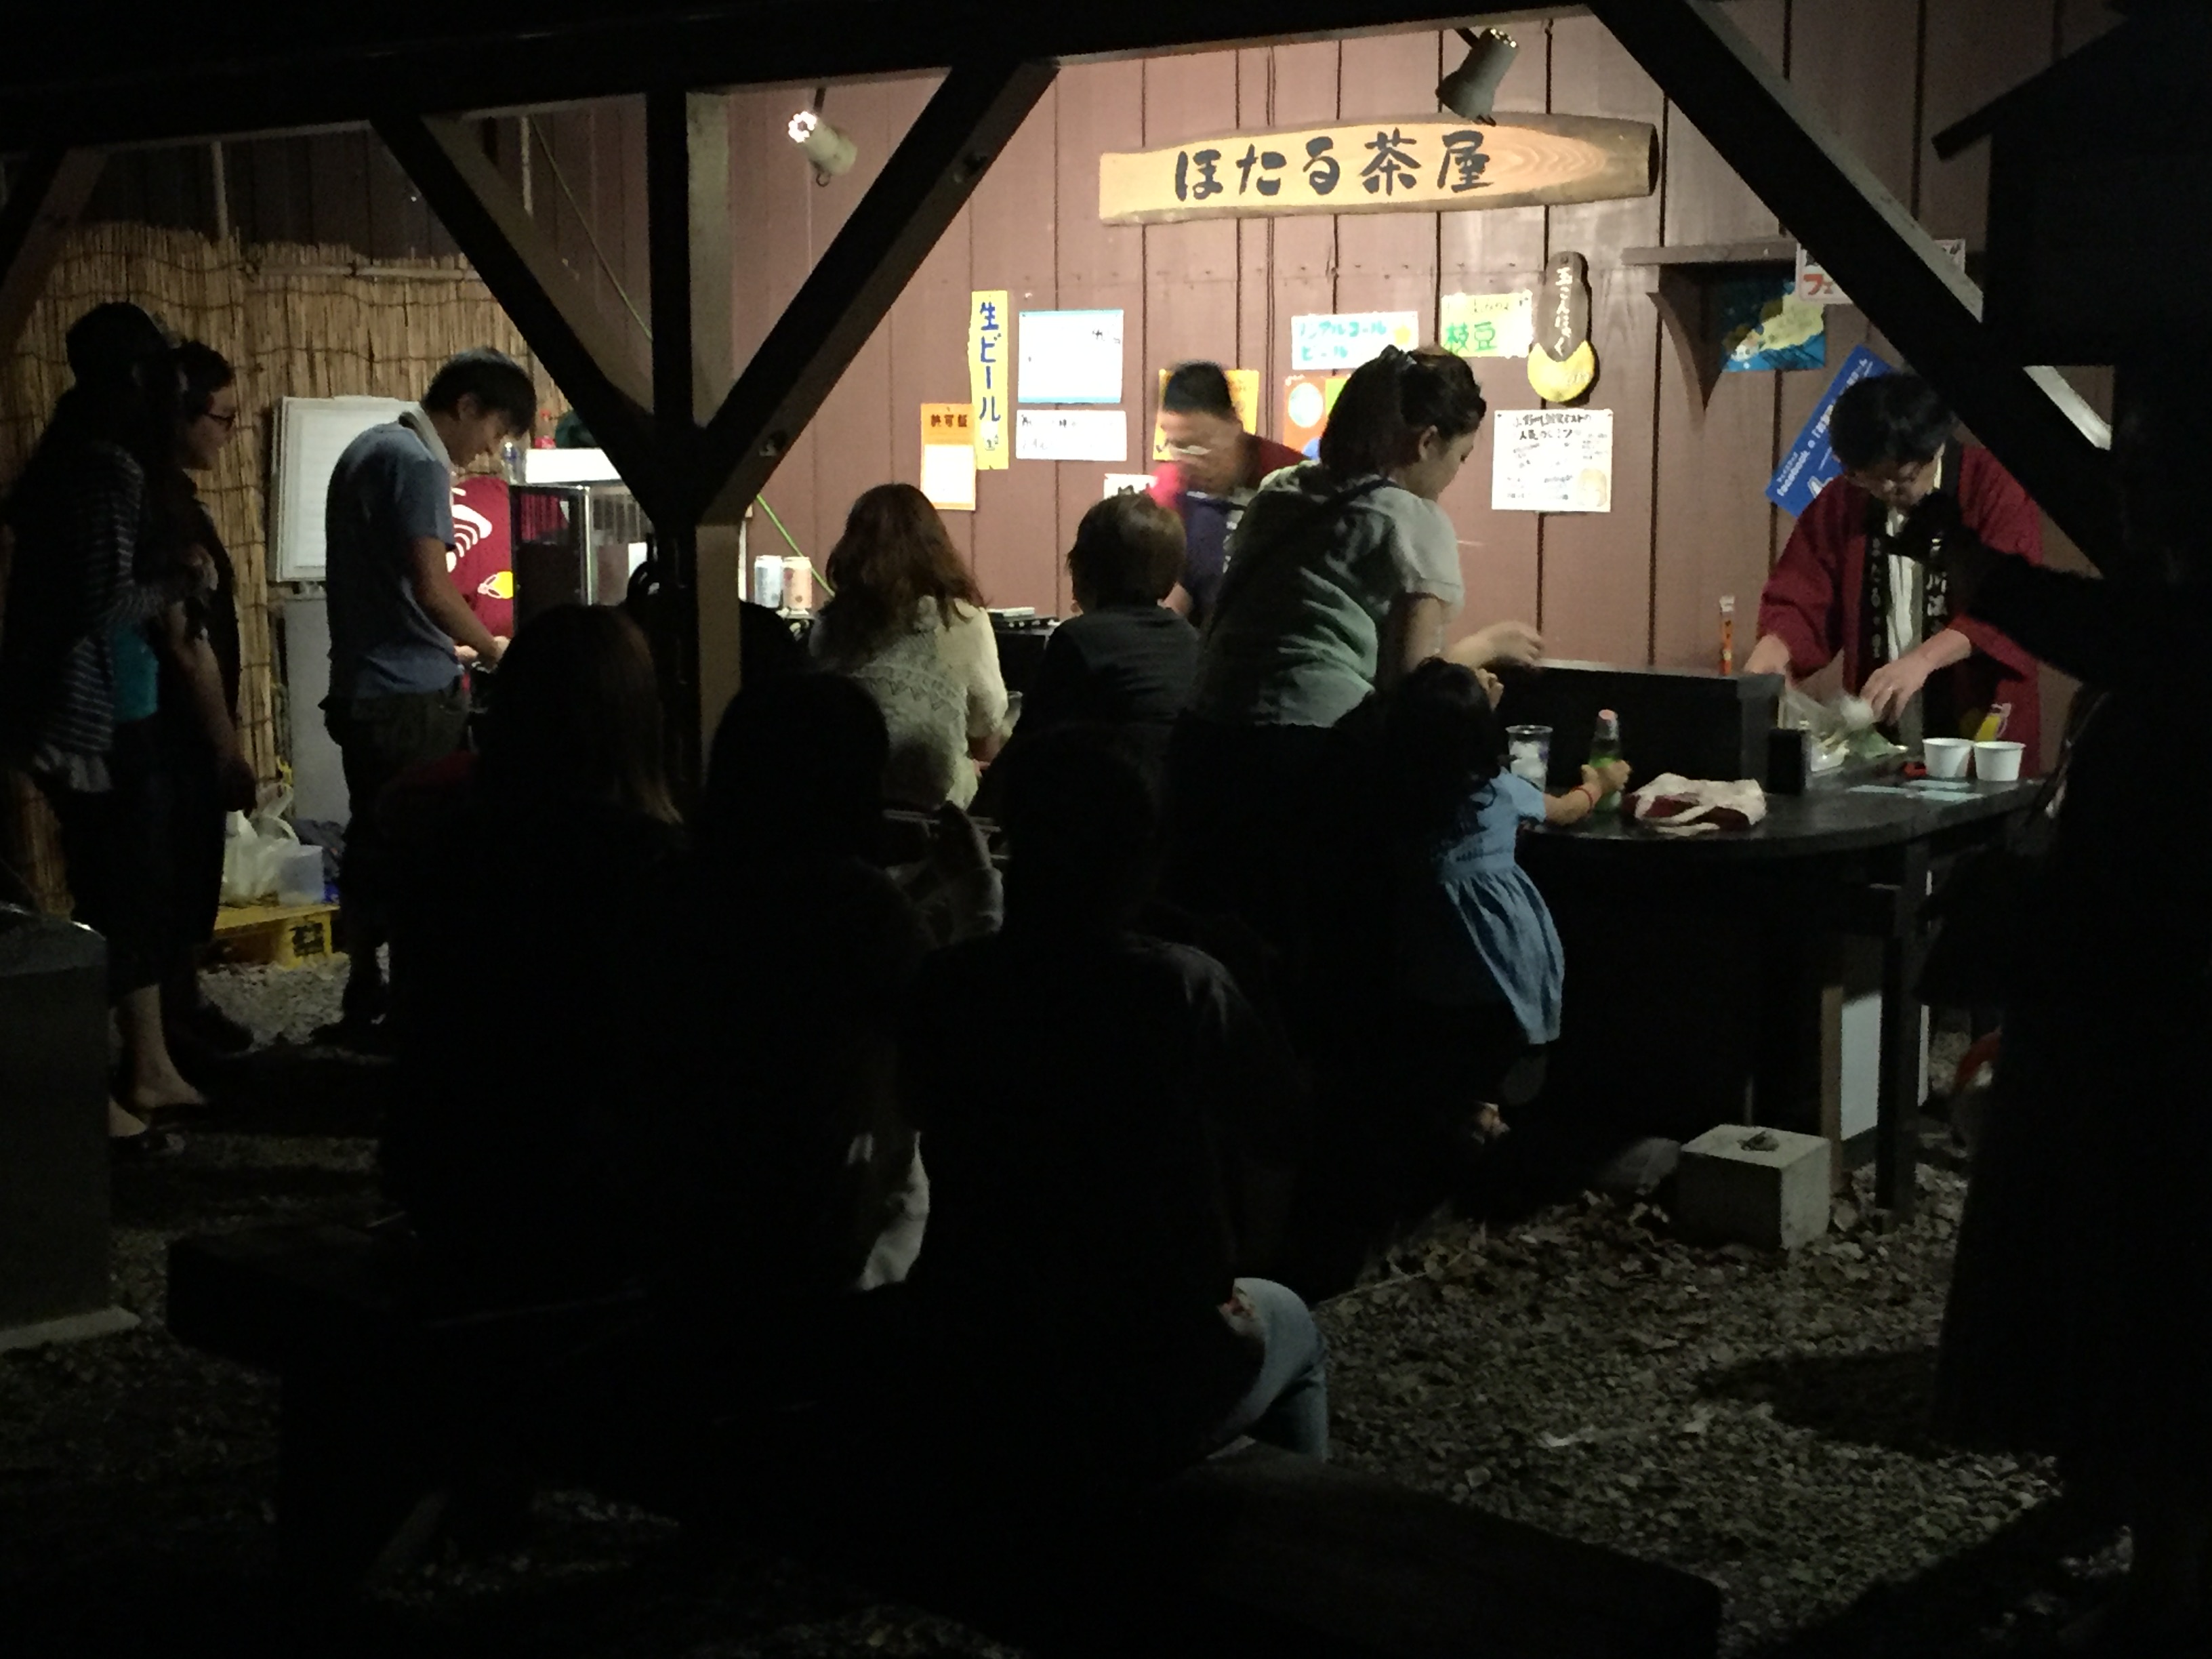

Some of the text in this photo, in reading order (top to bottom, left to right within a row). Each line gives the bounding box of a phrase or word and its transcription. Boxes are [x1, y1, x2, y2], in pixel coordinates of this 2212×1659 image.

[1174, 127, 1494, 202] ほたる茶屋
[1300, 320, 1387, 340] ノンアルコール
[1443, 321, 1498, 352] 枝豆
[979, 302, 1002, 422] 生ビール
[1301, 346, 1349, 362] ビール
